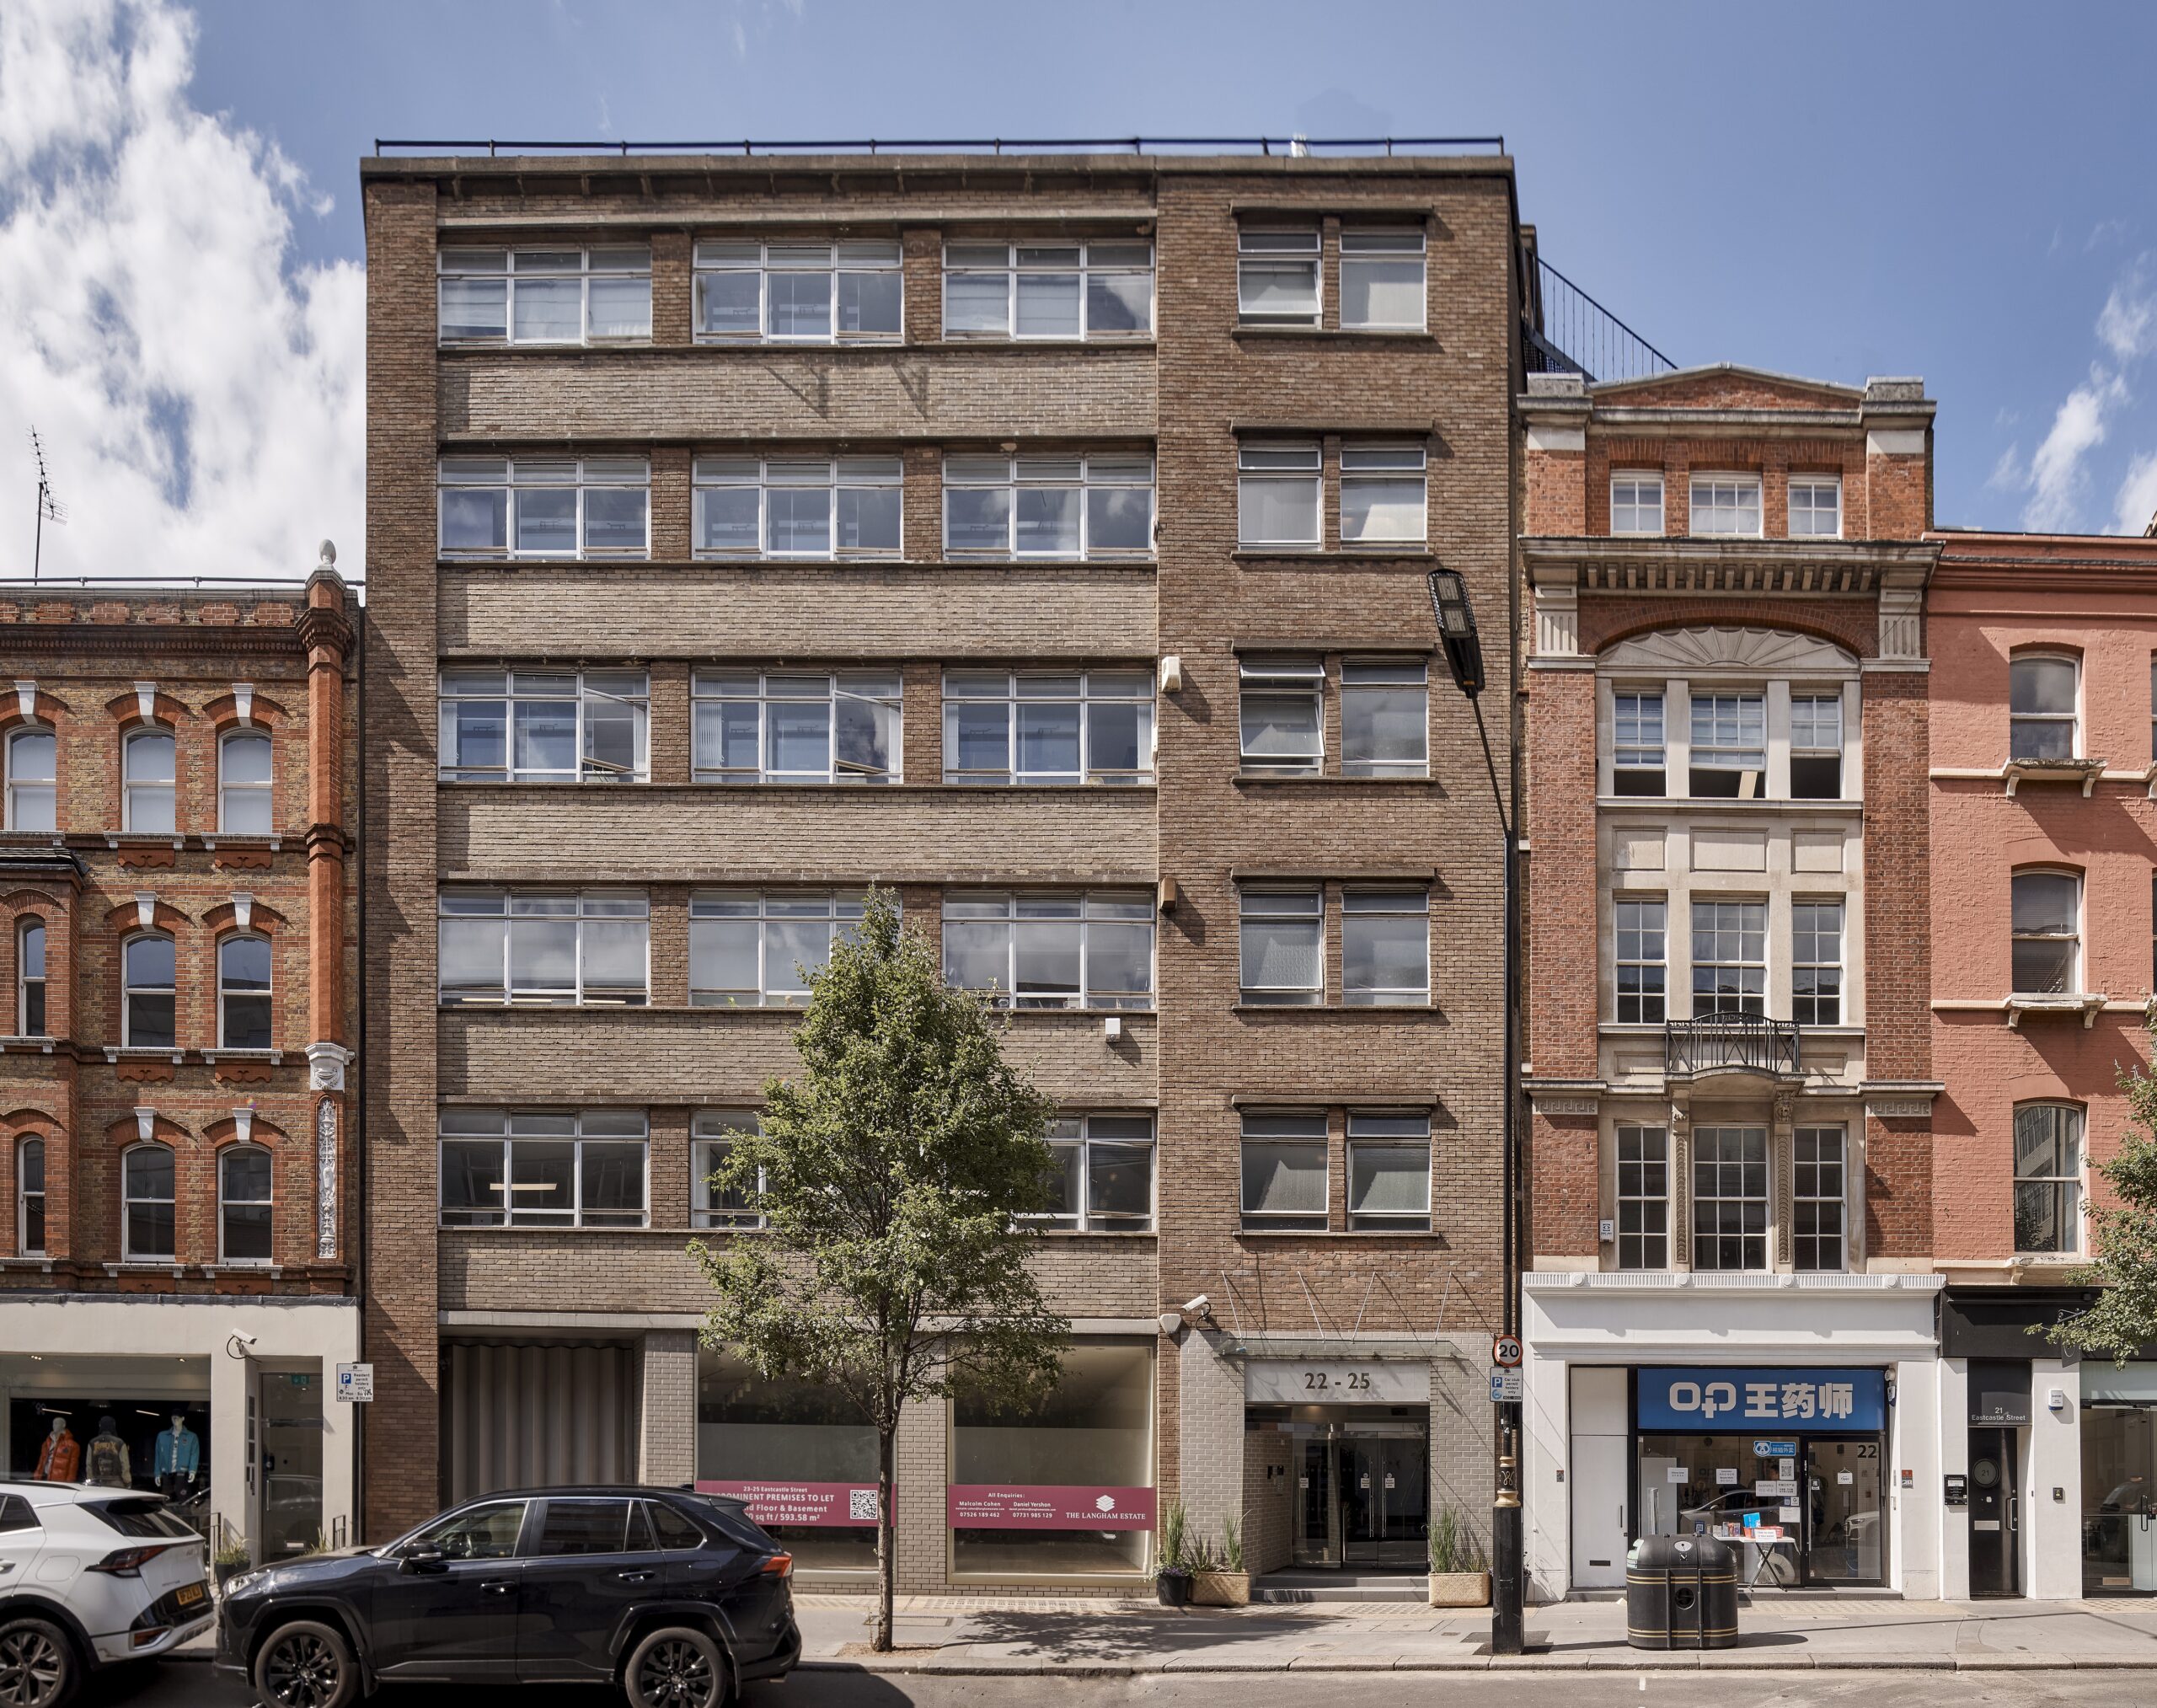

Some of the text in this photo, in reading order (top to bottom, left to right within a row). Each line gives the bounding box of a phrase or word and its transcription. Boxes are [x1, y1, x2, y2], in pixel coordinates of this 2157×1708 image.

[1499, 1344, 1519, 1357] 20
[343, 1374, 350, 1384] P
[1305, 1373, 1328, 1389] 22
[1347, 1373, 1370, 1389] 25
[1494, 1378, 1501, 1387] P
[1744, 1383, 1854, 1419] 王药师
[1857, 1445, 1876, 1458] 22
